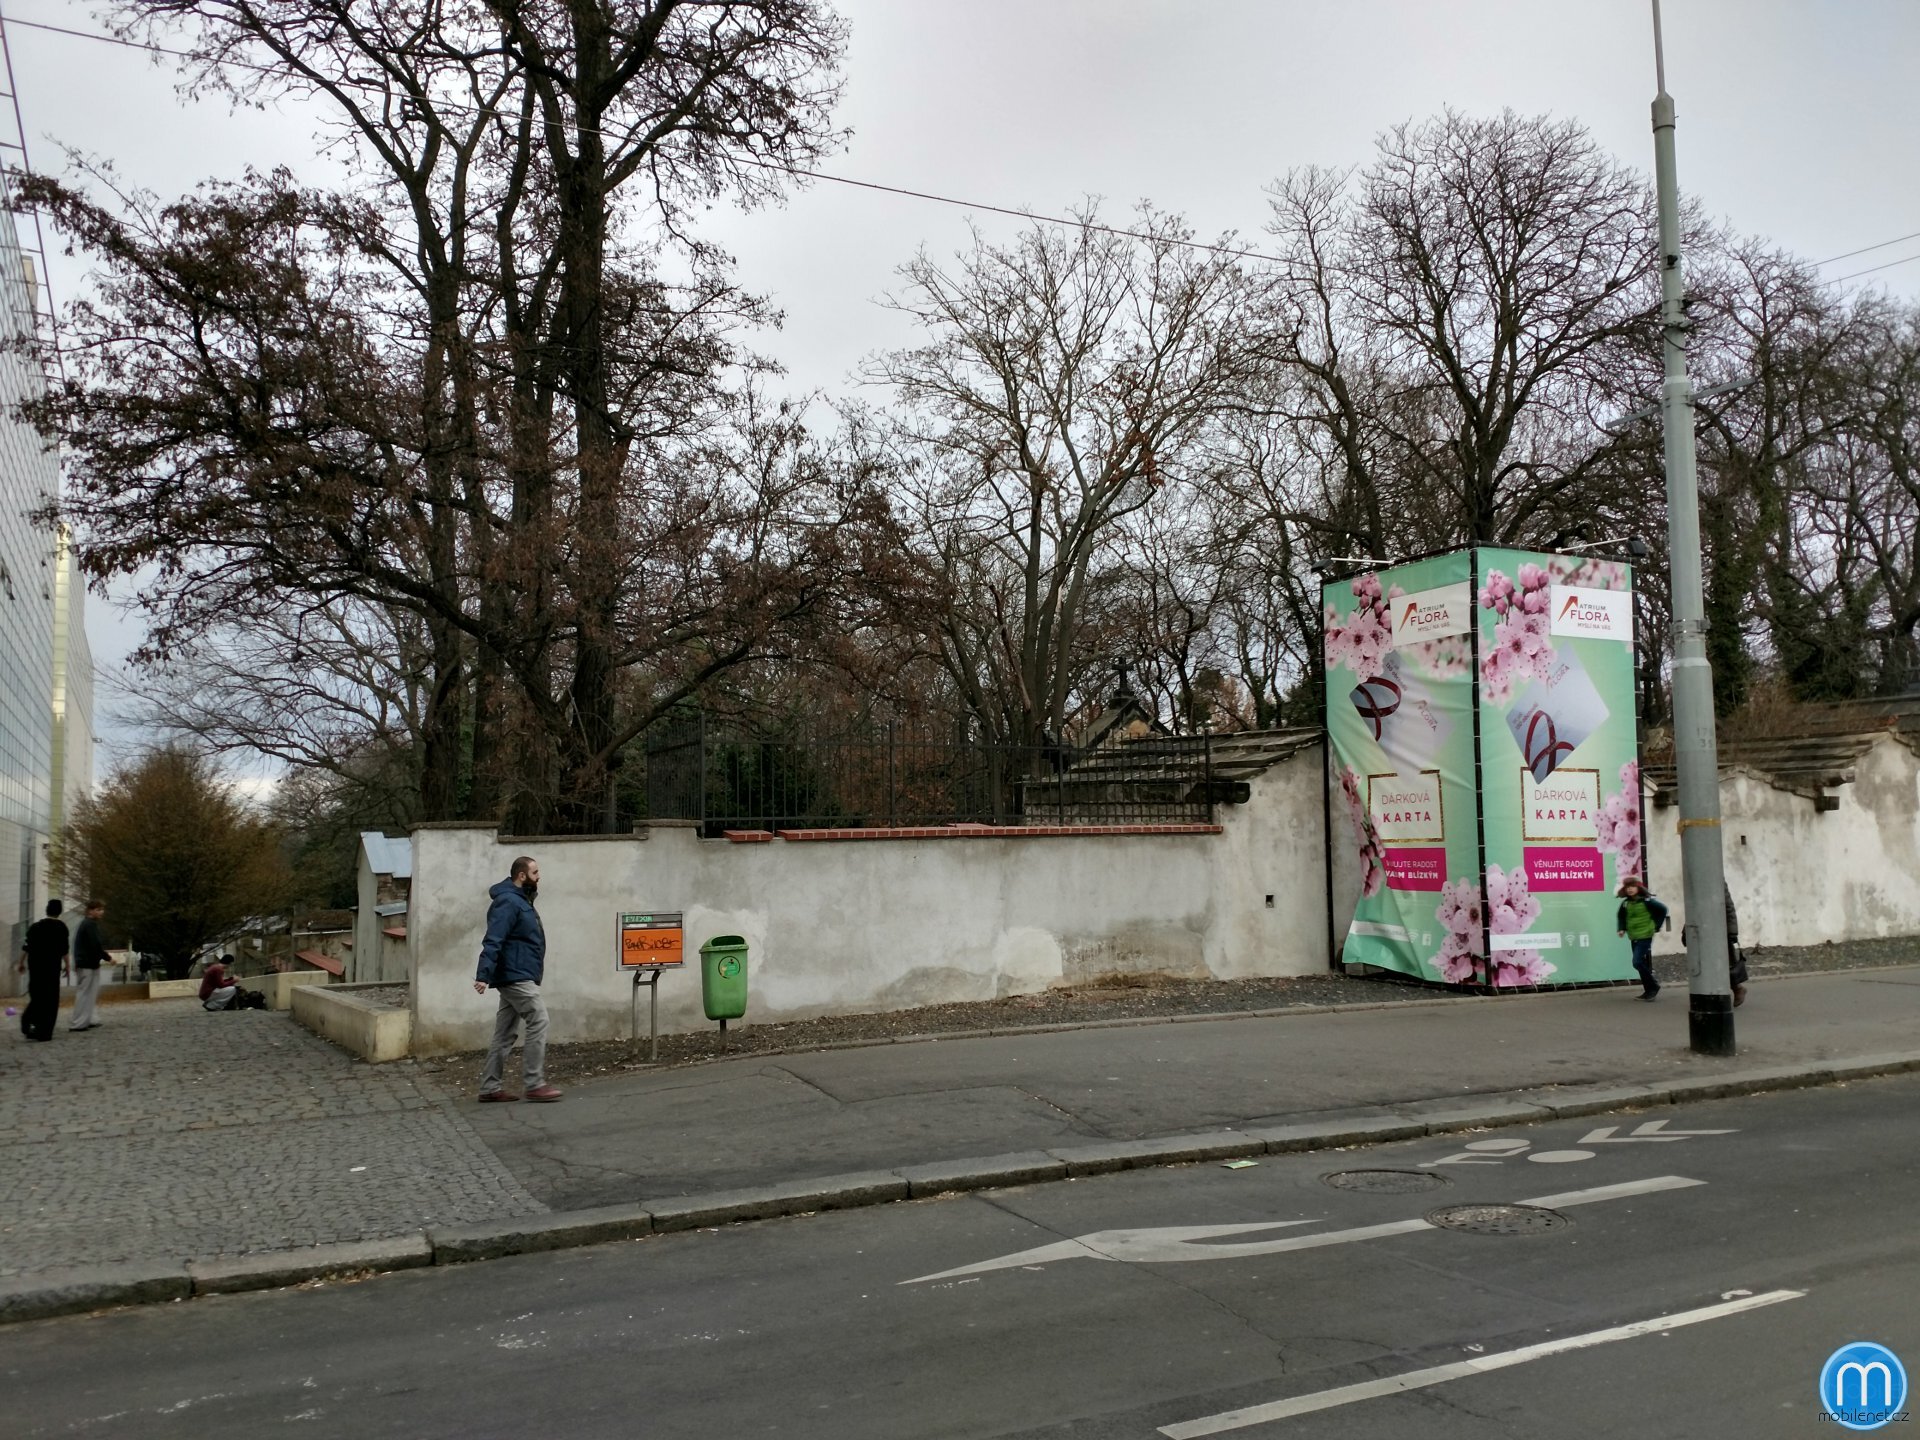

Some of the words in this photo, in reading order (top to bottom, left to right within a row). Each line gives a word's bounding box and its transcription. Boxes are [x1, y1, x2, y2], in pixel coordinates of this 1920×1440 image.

[1419, 603, 1445, 613] ATRIUM
[1410, 610, 1449, 626] FLORA
[1570, 609, 1611, 622] FLORA
[1534, 788, 1588, 801] DÁRKOVÁ
[1383, 811, 1432, 823] KARTA
[1535, 809, 1588, 820] KARTA
[1412, 860, 1438, 868] RADOST
[1533, 859, 1564, 868] VĚNUJTE
[1565, 860, 1594, 868] RADOST
[1534, 870, 1559, 880] VAŠIM
[1560, 870, 1595, 880] BLÍZKÝM
